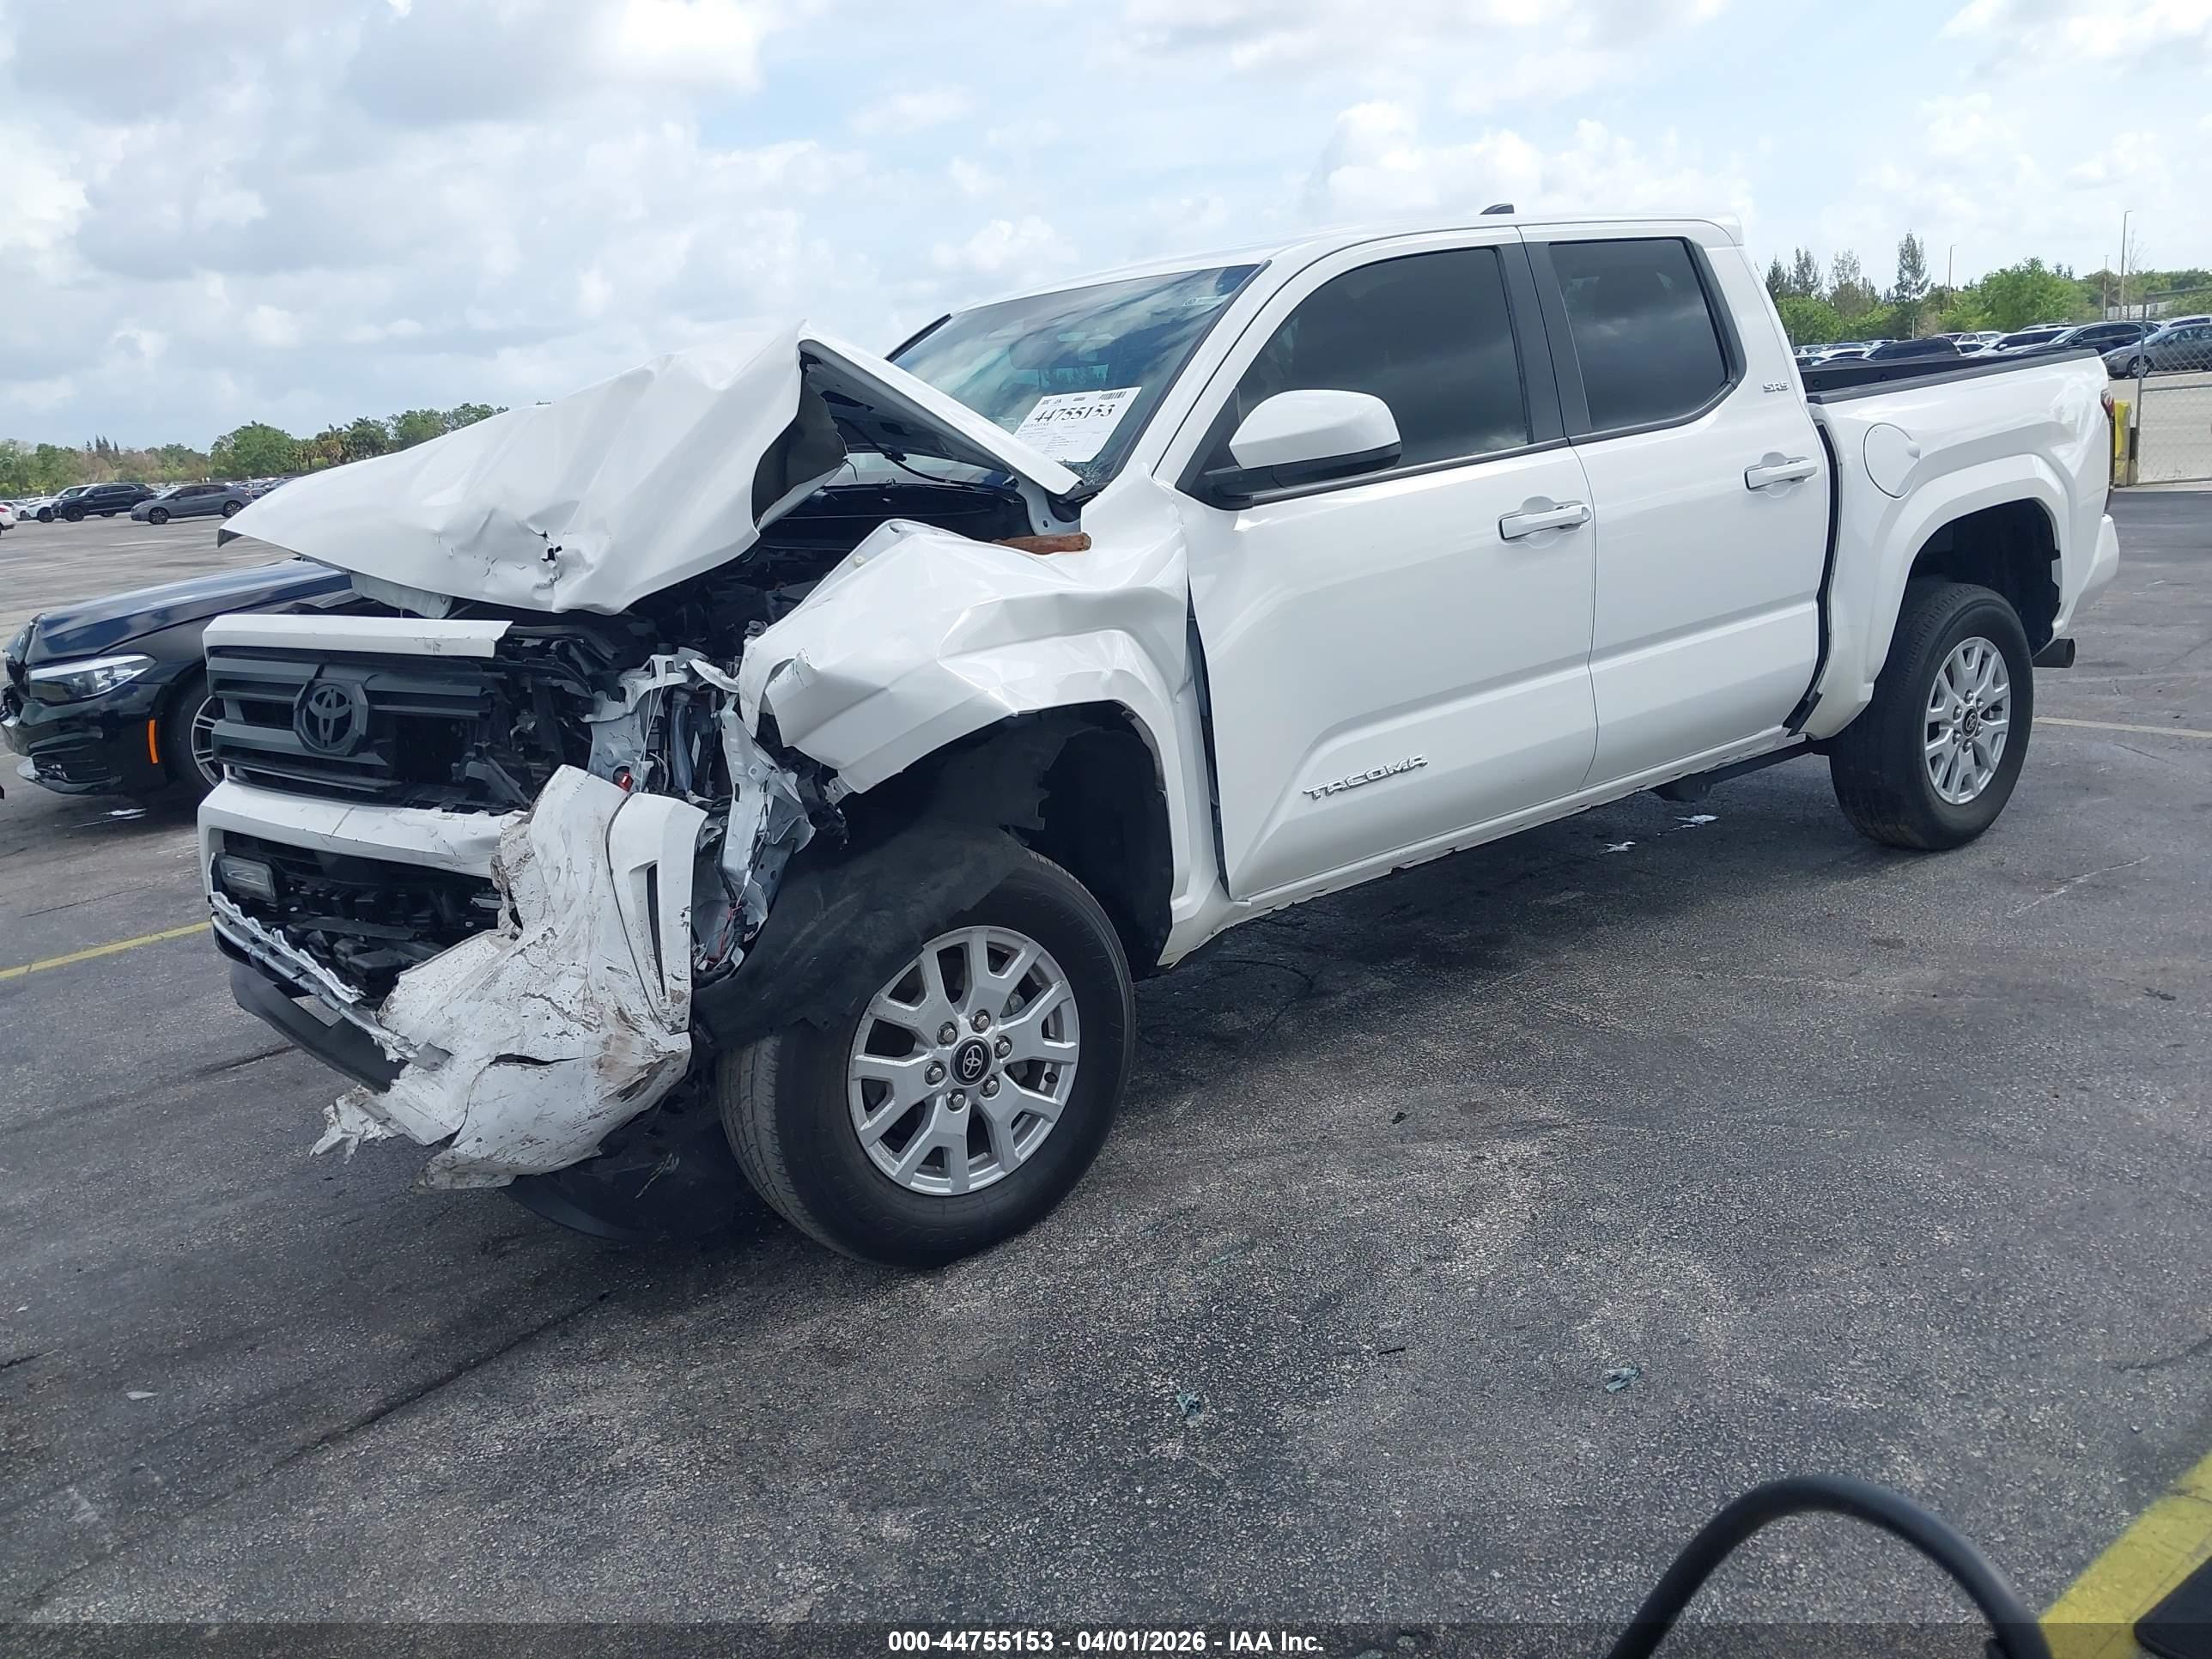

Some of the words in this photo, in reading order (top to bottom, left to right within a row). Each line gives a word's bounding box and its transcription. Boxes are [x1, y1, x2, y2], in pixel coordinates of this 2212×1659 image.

[1763, 380, 1790, 392] SR5
[1034, 404, 1115, 422] 44755153
[1302, 754, 1429, 800] TACOMA
